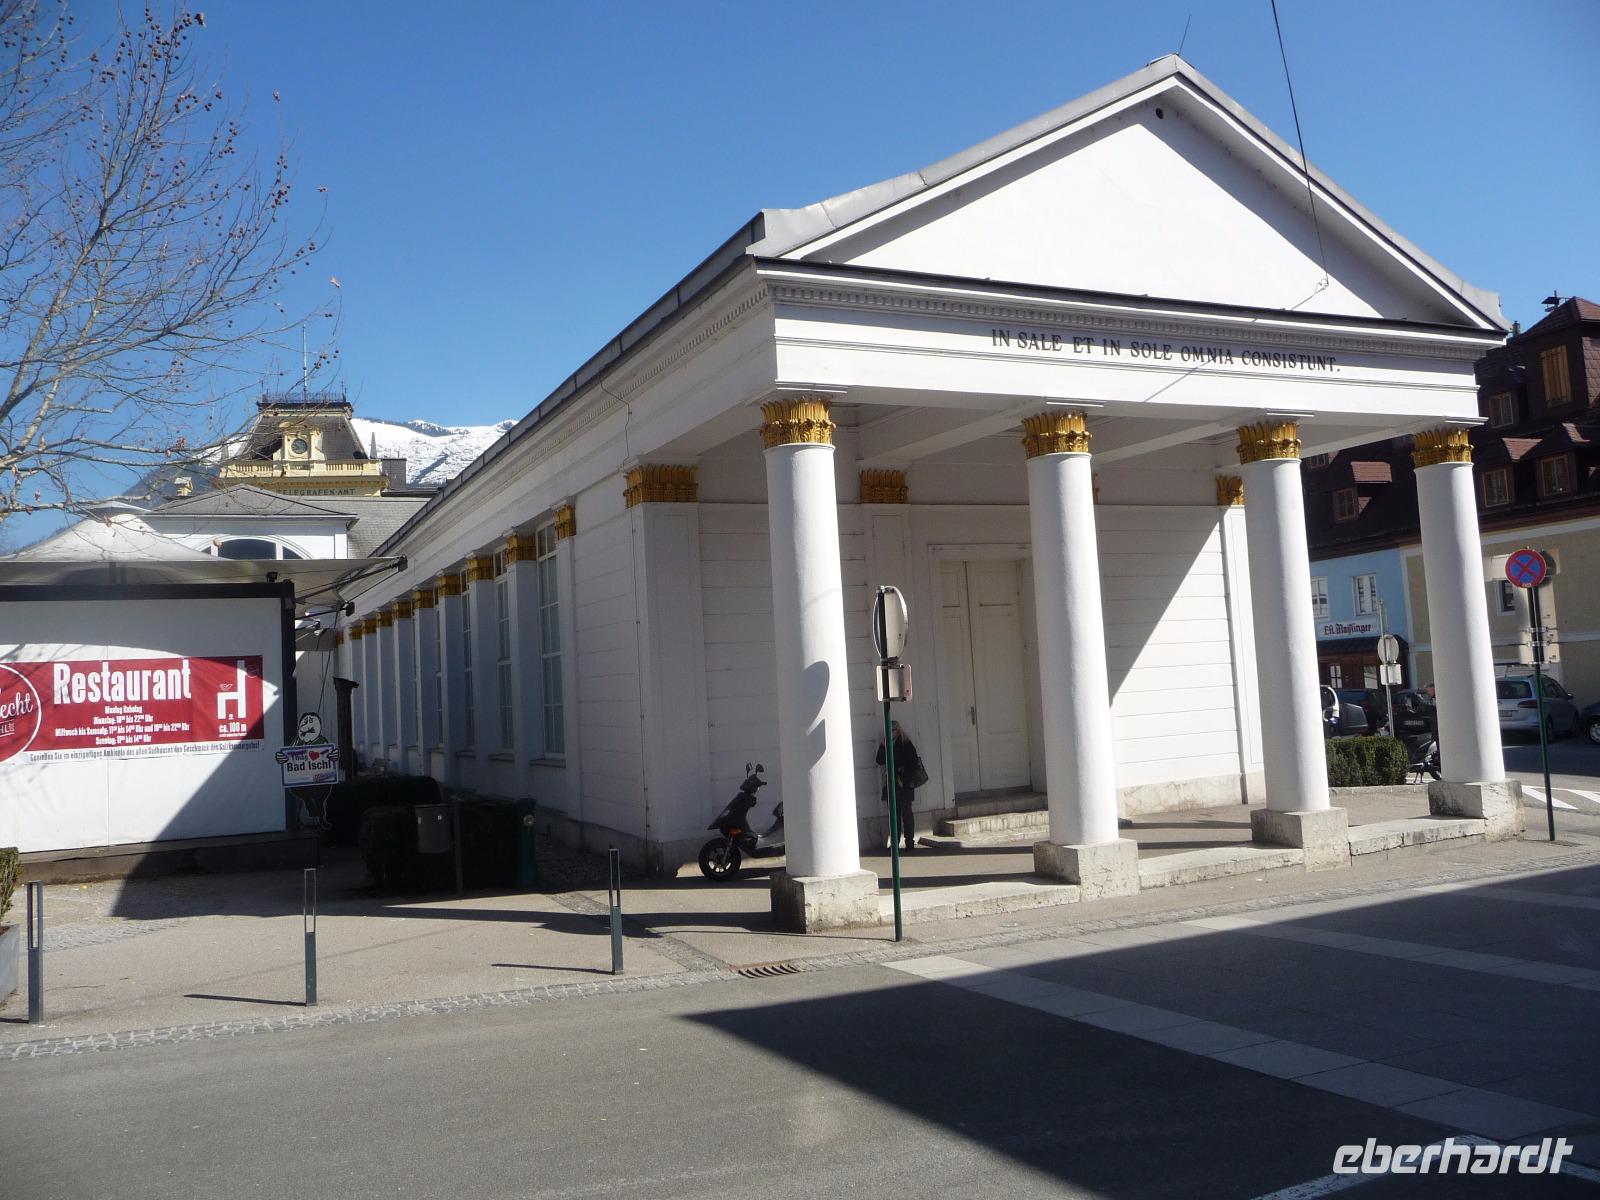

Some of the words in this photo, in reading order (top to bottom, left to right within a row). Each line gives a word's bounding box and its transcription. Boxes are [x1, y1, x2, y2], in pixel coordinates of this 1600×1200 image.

[991, 328, 1011, 347] IN
[1017, 331, 1063, 352] SALE
[1072, 336, 1095, 354] ET
[1102, 338, 1121, 356] IN
[1130, 341, 1173, 361] SOLE
[1180, 346, 1234, 365] OMNIA
[1241, 350, 1341, 372] CONSISTUNT.
[53, 659, 191, 705] Restaurant
[0, 692, 34, 718] echt
[287, 762, 305, 772] Bad
[308, 760, 331, 771] Ischl
